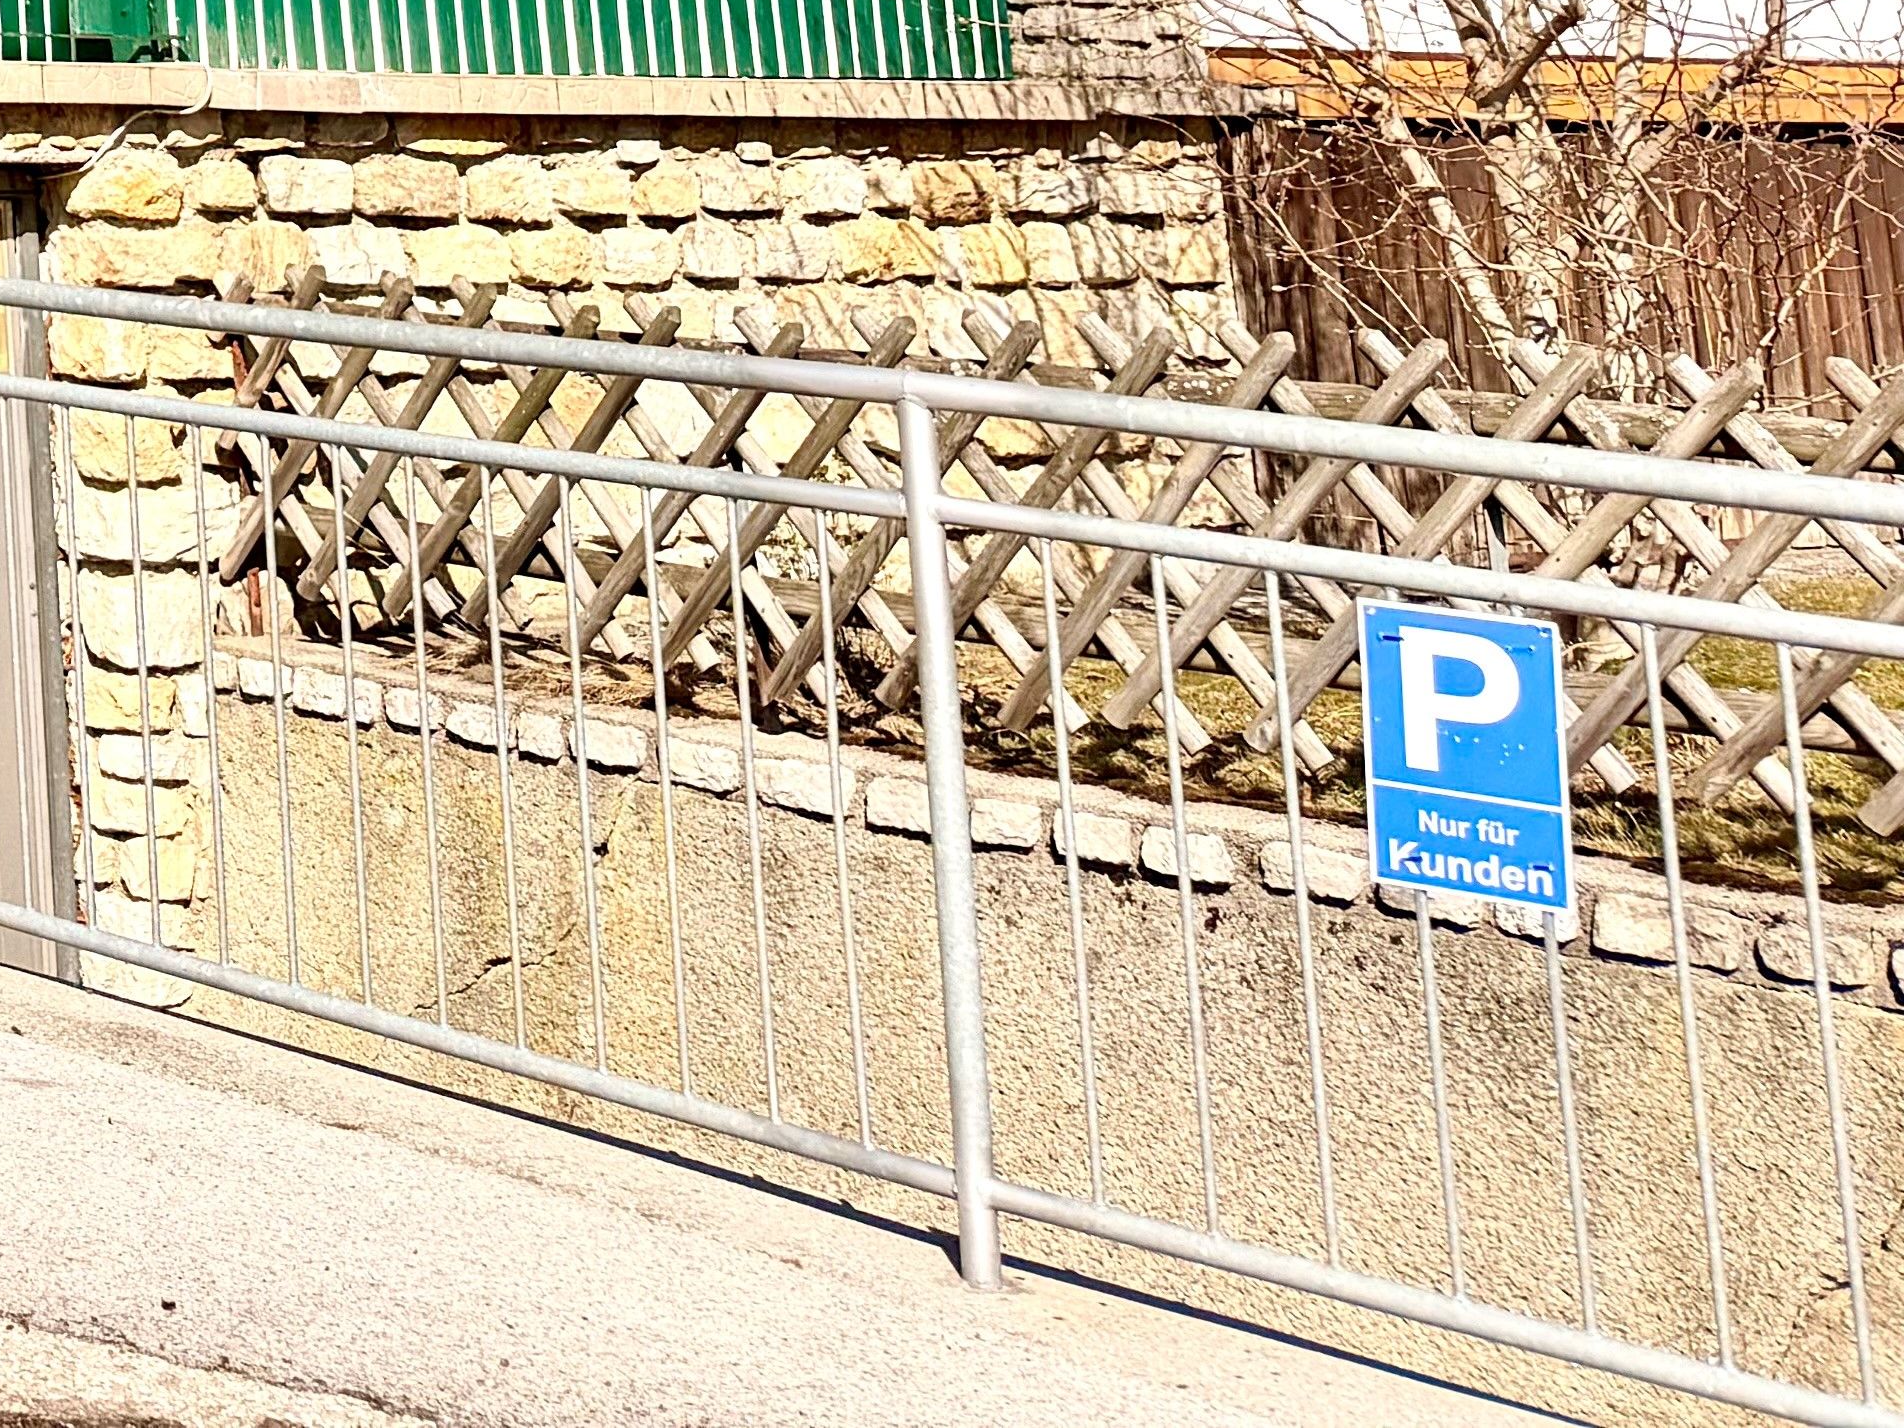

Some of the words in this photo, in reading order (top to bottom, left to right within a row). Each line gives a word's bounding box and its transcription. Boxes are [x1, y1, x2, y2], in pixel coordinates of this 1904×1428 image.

[1398, 624, 1521, 773] P
[1417, 808, 1470, 837] Nur
[1475, 817, 1521, 847] für
[1388, 836, 1555, 897] Kunden
